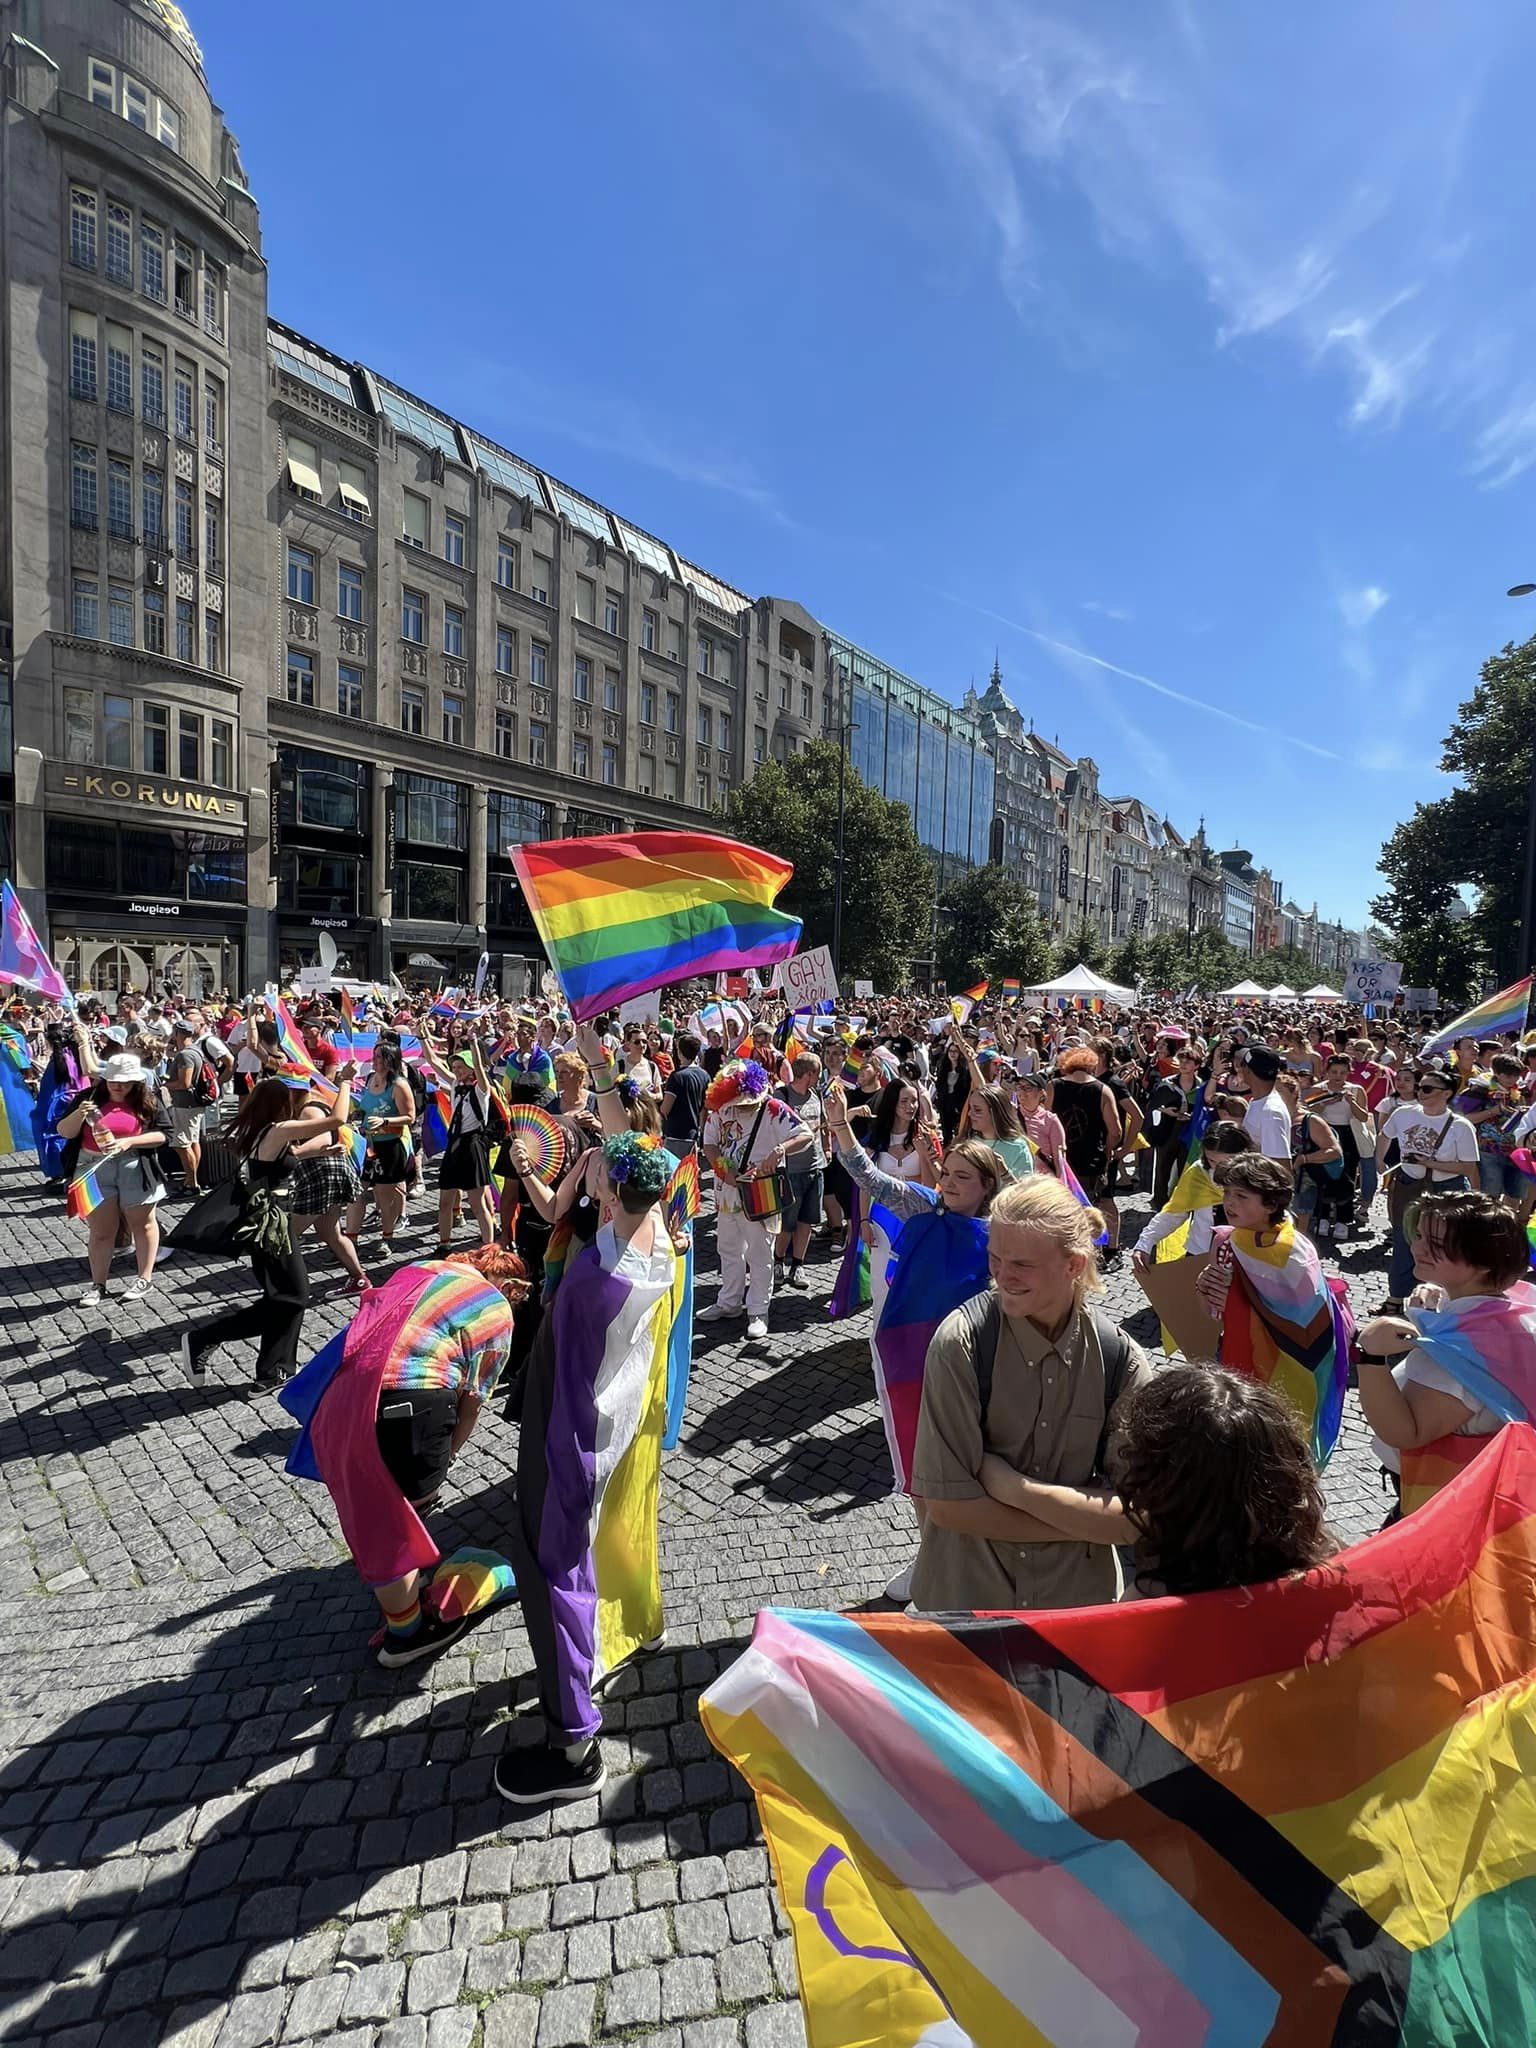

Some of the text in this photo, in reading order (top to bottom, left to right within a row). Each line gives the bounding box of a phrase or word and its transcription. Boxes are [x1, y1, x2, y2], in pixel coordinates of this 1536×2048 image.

[1060, 847, 1069, 895] CASINO
[788, 951, 826, 987] GAY
[1357, 976, 1378, 990] OR
